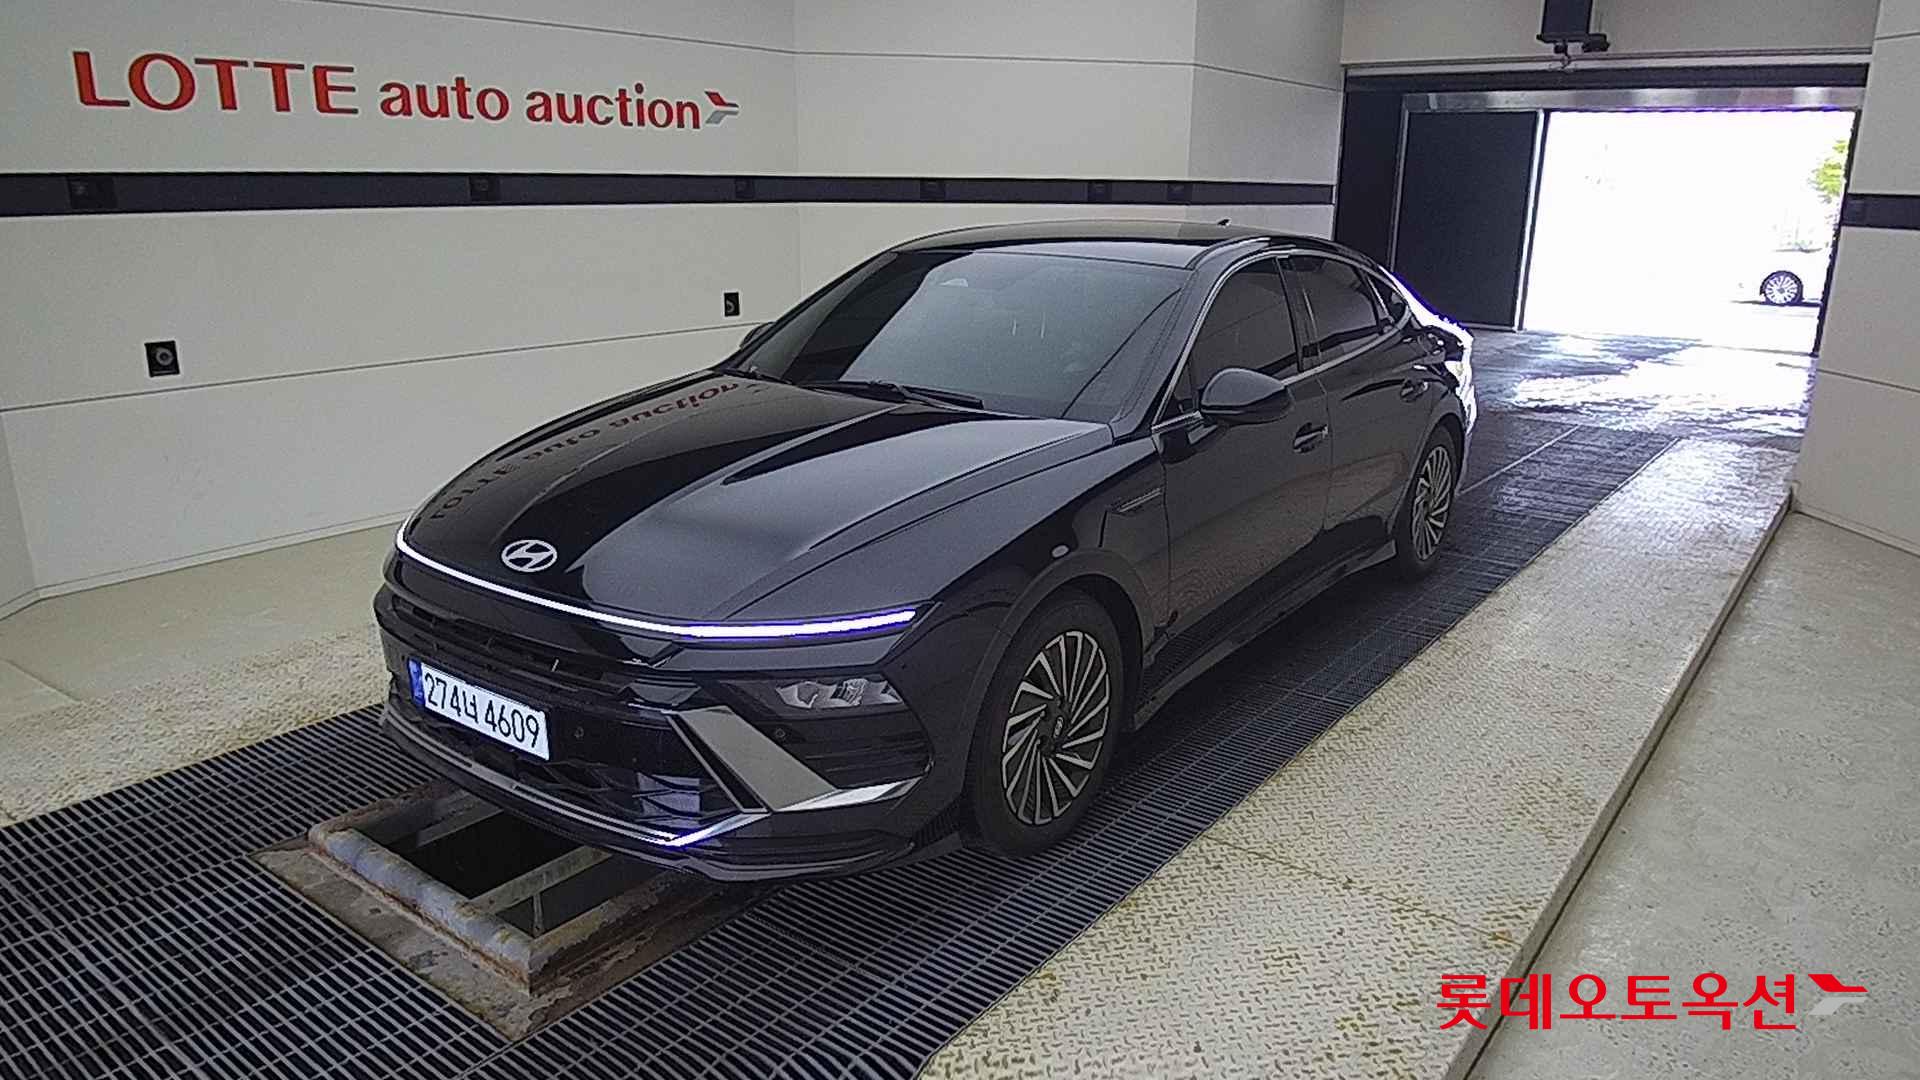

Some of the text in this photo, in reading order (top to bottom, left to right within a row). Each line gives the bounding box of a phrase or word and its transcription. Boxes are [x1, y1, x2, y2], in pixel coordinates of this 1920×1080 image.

[74, 51, 701, 129] LOTTE auto auction
[424, 672, 540, 749] 274너 4609
